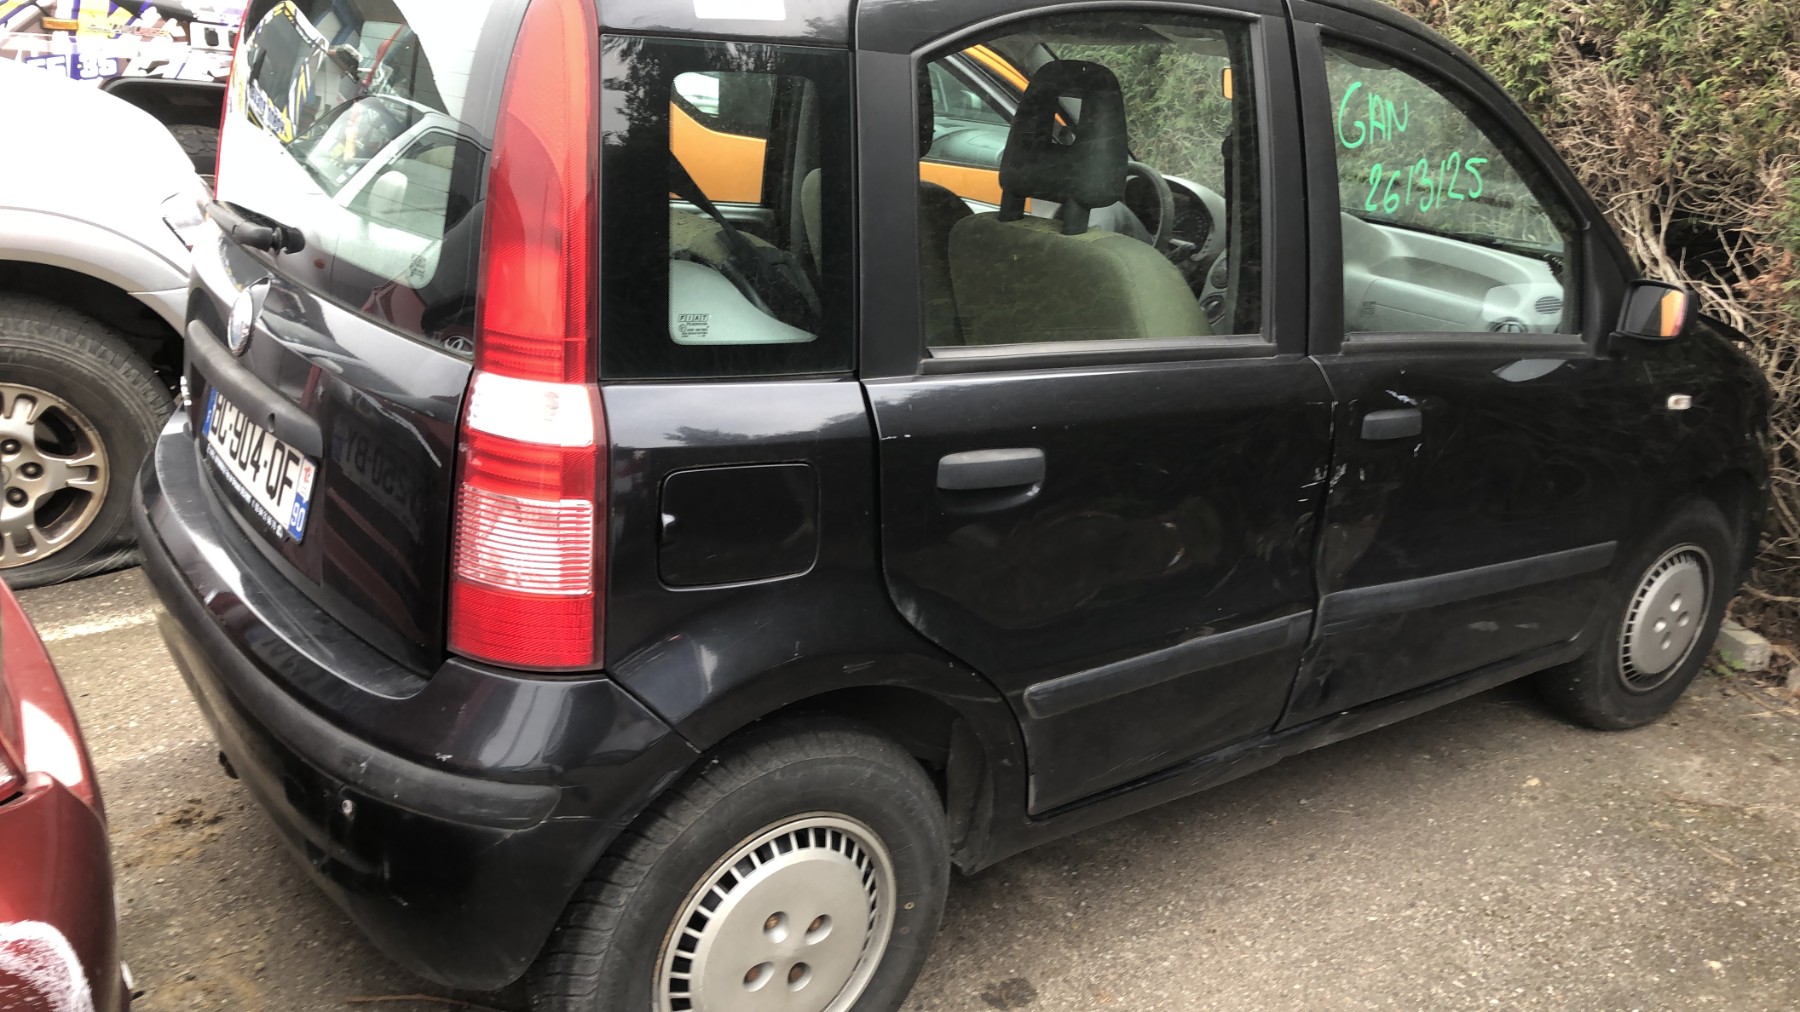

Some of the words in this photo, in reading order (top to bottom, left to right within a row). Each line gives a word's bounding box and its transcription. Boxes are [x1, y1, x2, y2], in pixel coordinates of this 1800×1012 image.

[1338, 81, 1409, 149] GAN
[1365, 151, 1488, 213] 26/3/25
[679, 314, 708, 322] FIAT
[290, 502, 306, 532] 90
